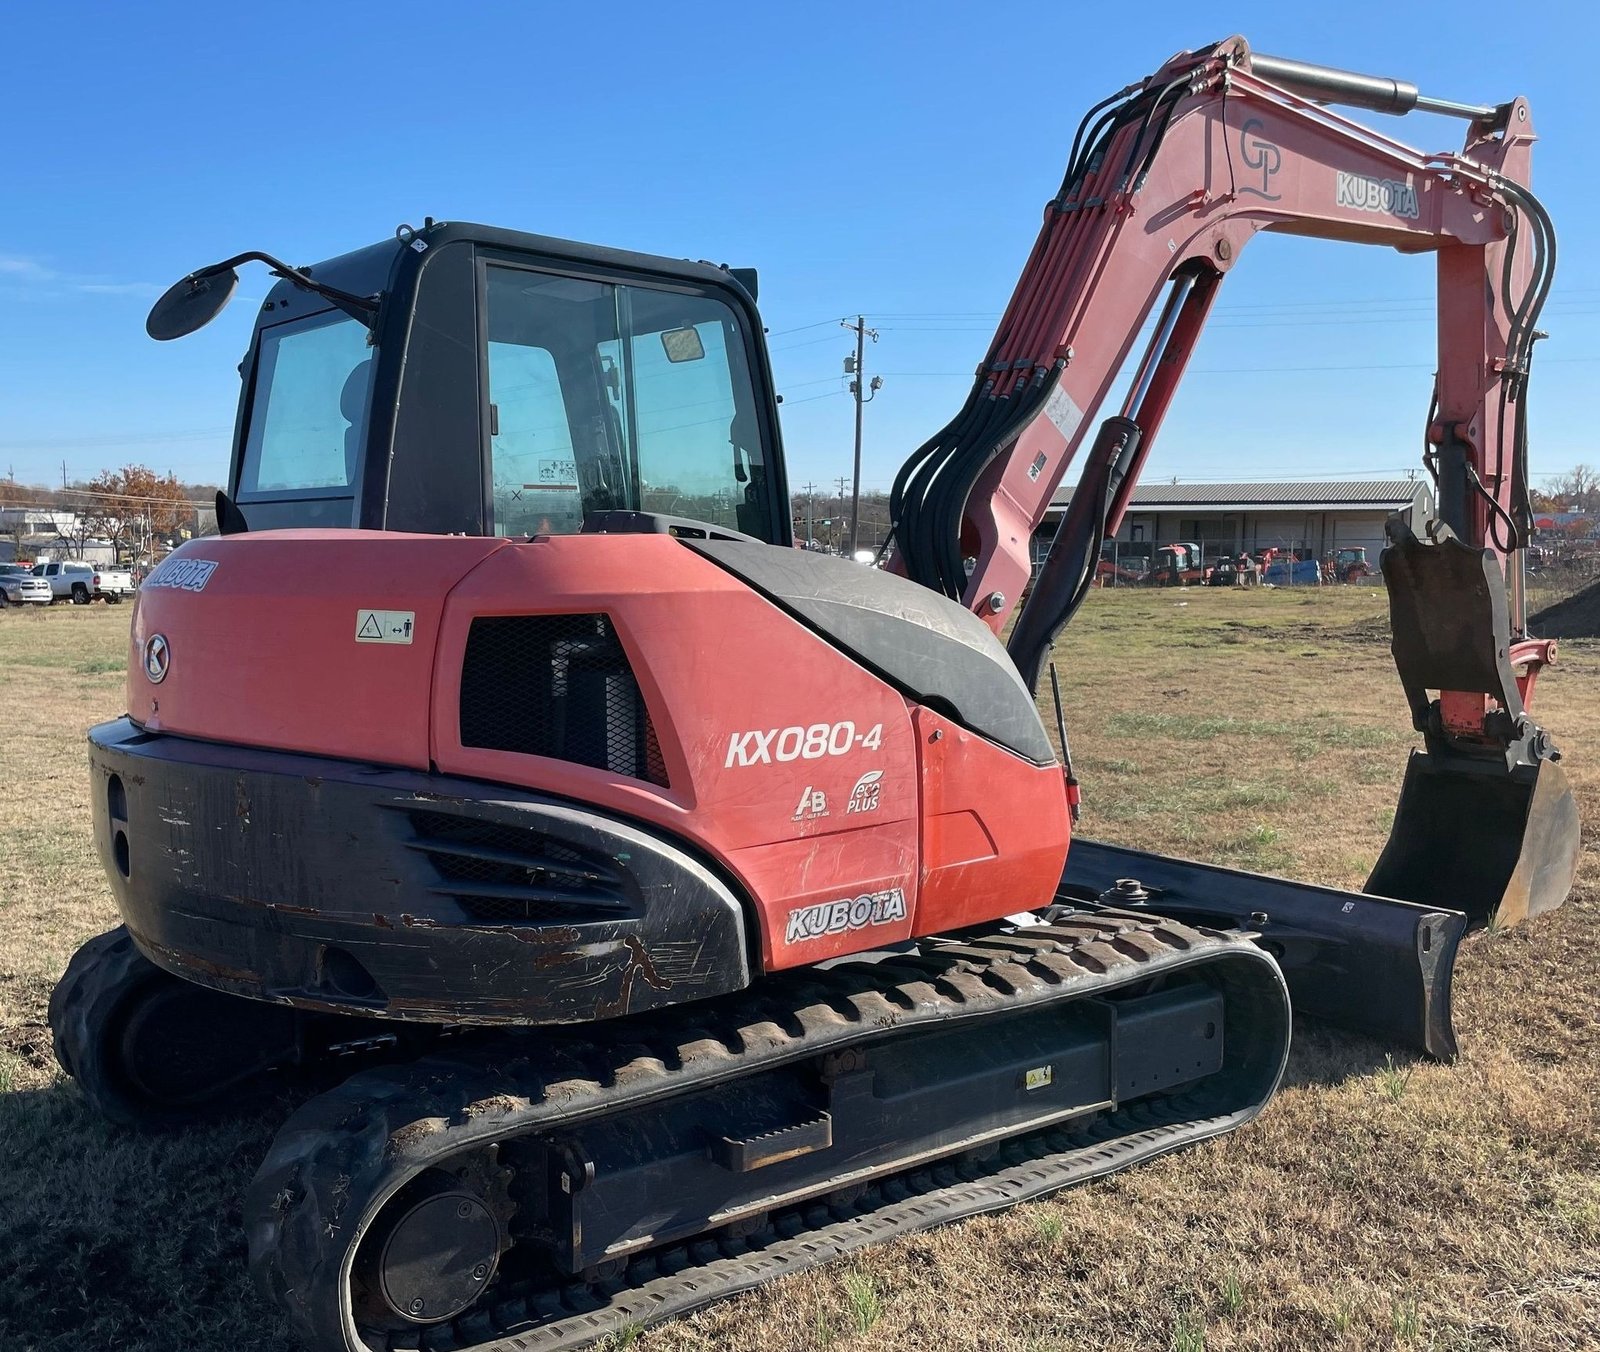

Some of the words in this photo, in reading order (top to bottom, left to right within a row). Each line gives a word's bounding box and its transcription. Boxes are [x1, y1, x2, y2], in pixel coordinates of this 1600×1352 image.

[1337, 171, 1418, 219] KUBOTA
[724, 721, 883, 768] KX080-4
[846, 796, 879, 814] PLUS
[787, 889, 906, 943] KUBOTA
